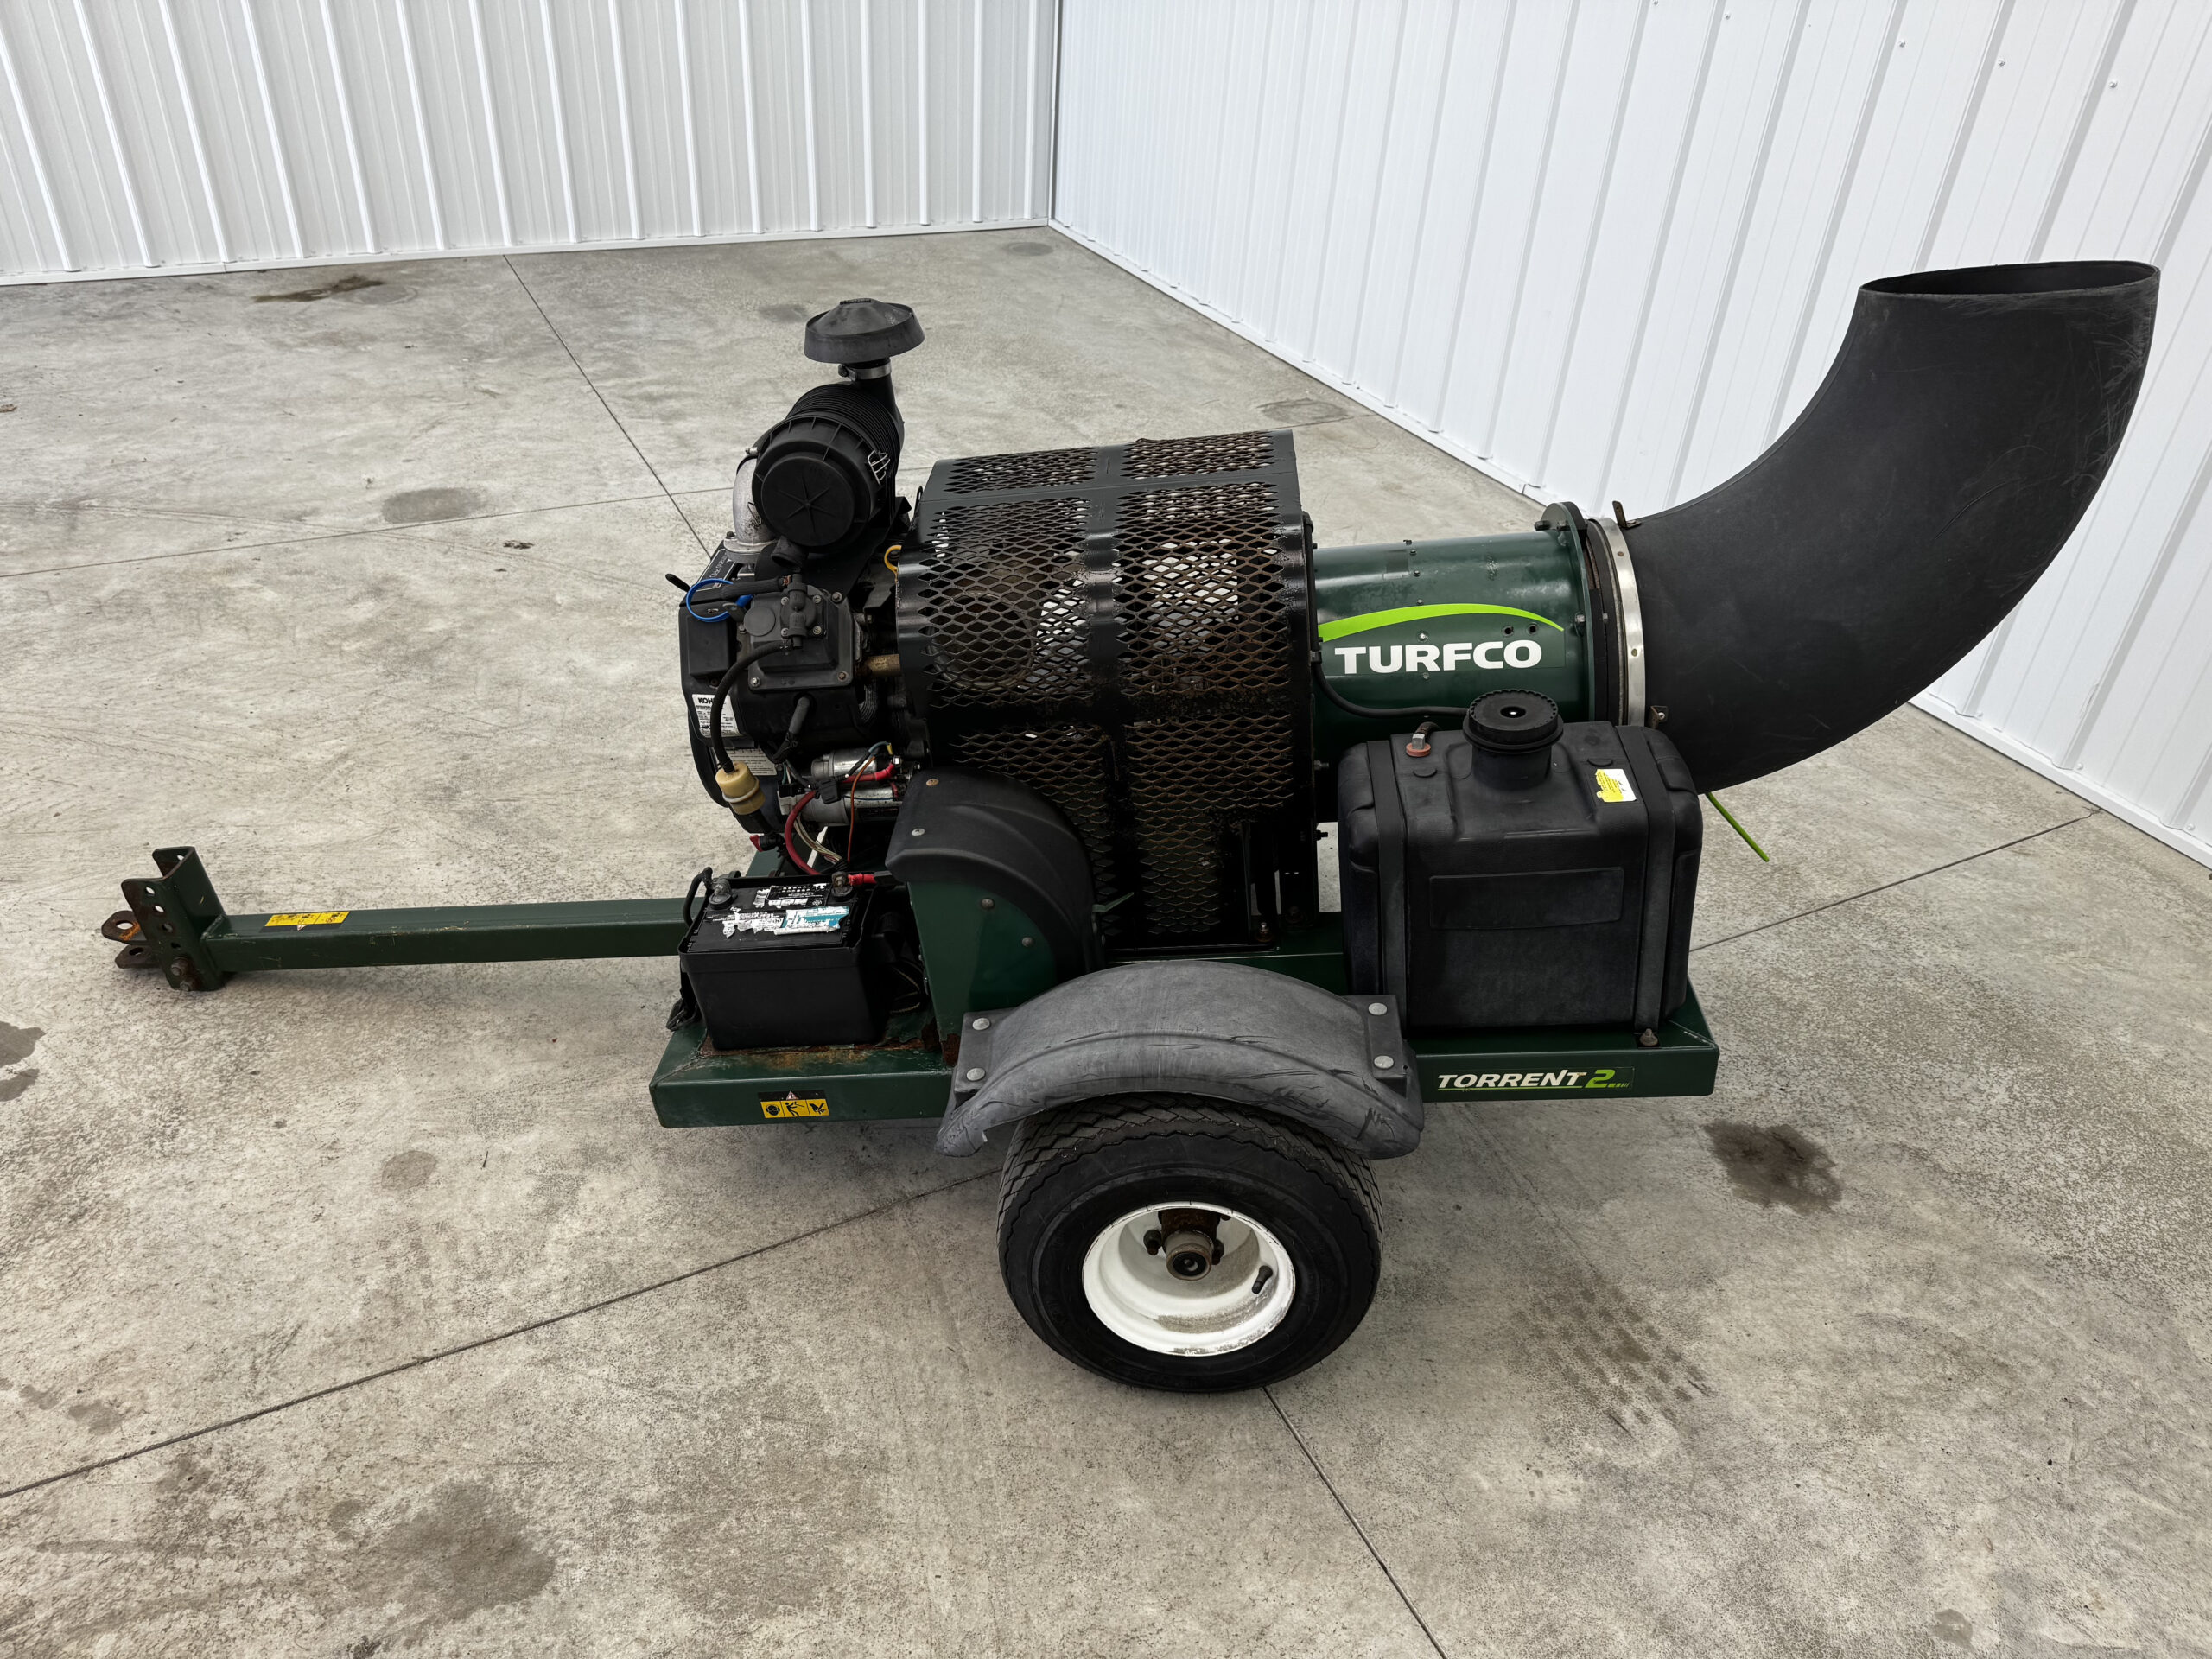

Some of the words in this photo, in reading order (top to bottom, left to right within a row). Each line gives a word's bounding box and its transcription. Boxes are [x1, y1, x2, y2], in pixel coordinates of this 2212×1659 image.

[1334, 639, 1542, 675] TURFCO
[1438, 1069, 1586, 1089] TORRENT
[1585, 1069, 1616, 1089] 2
